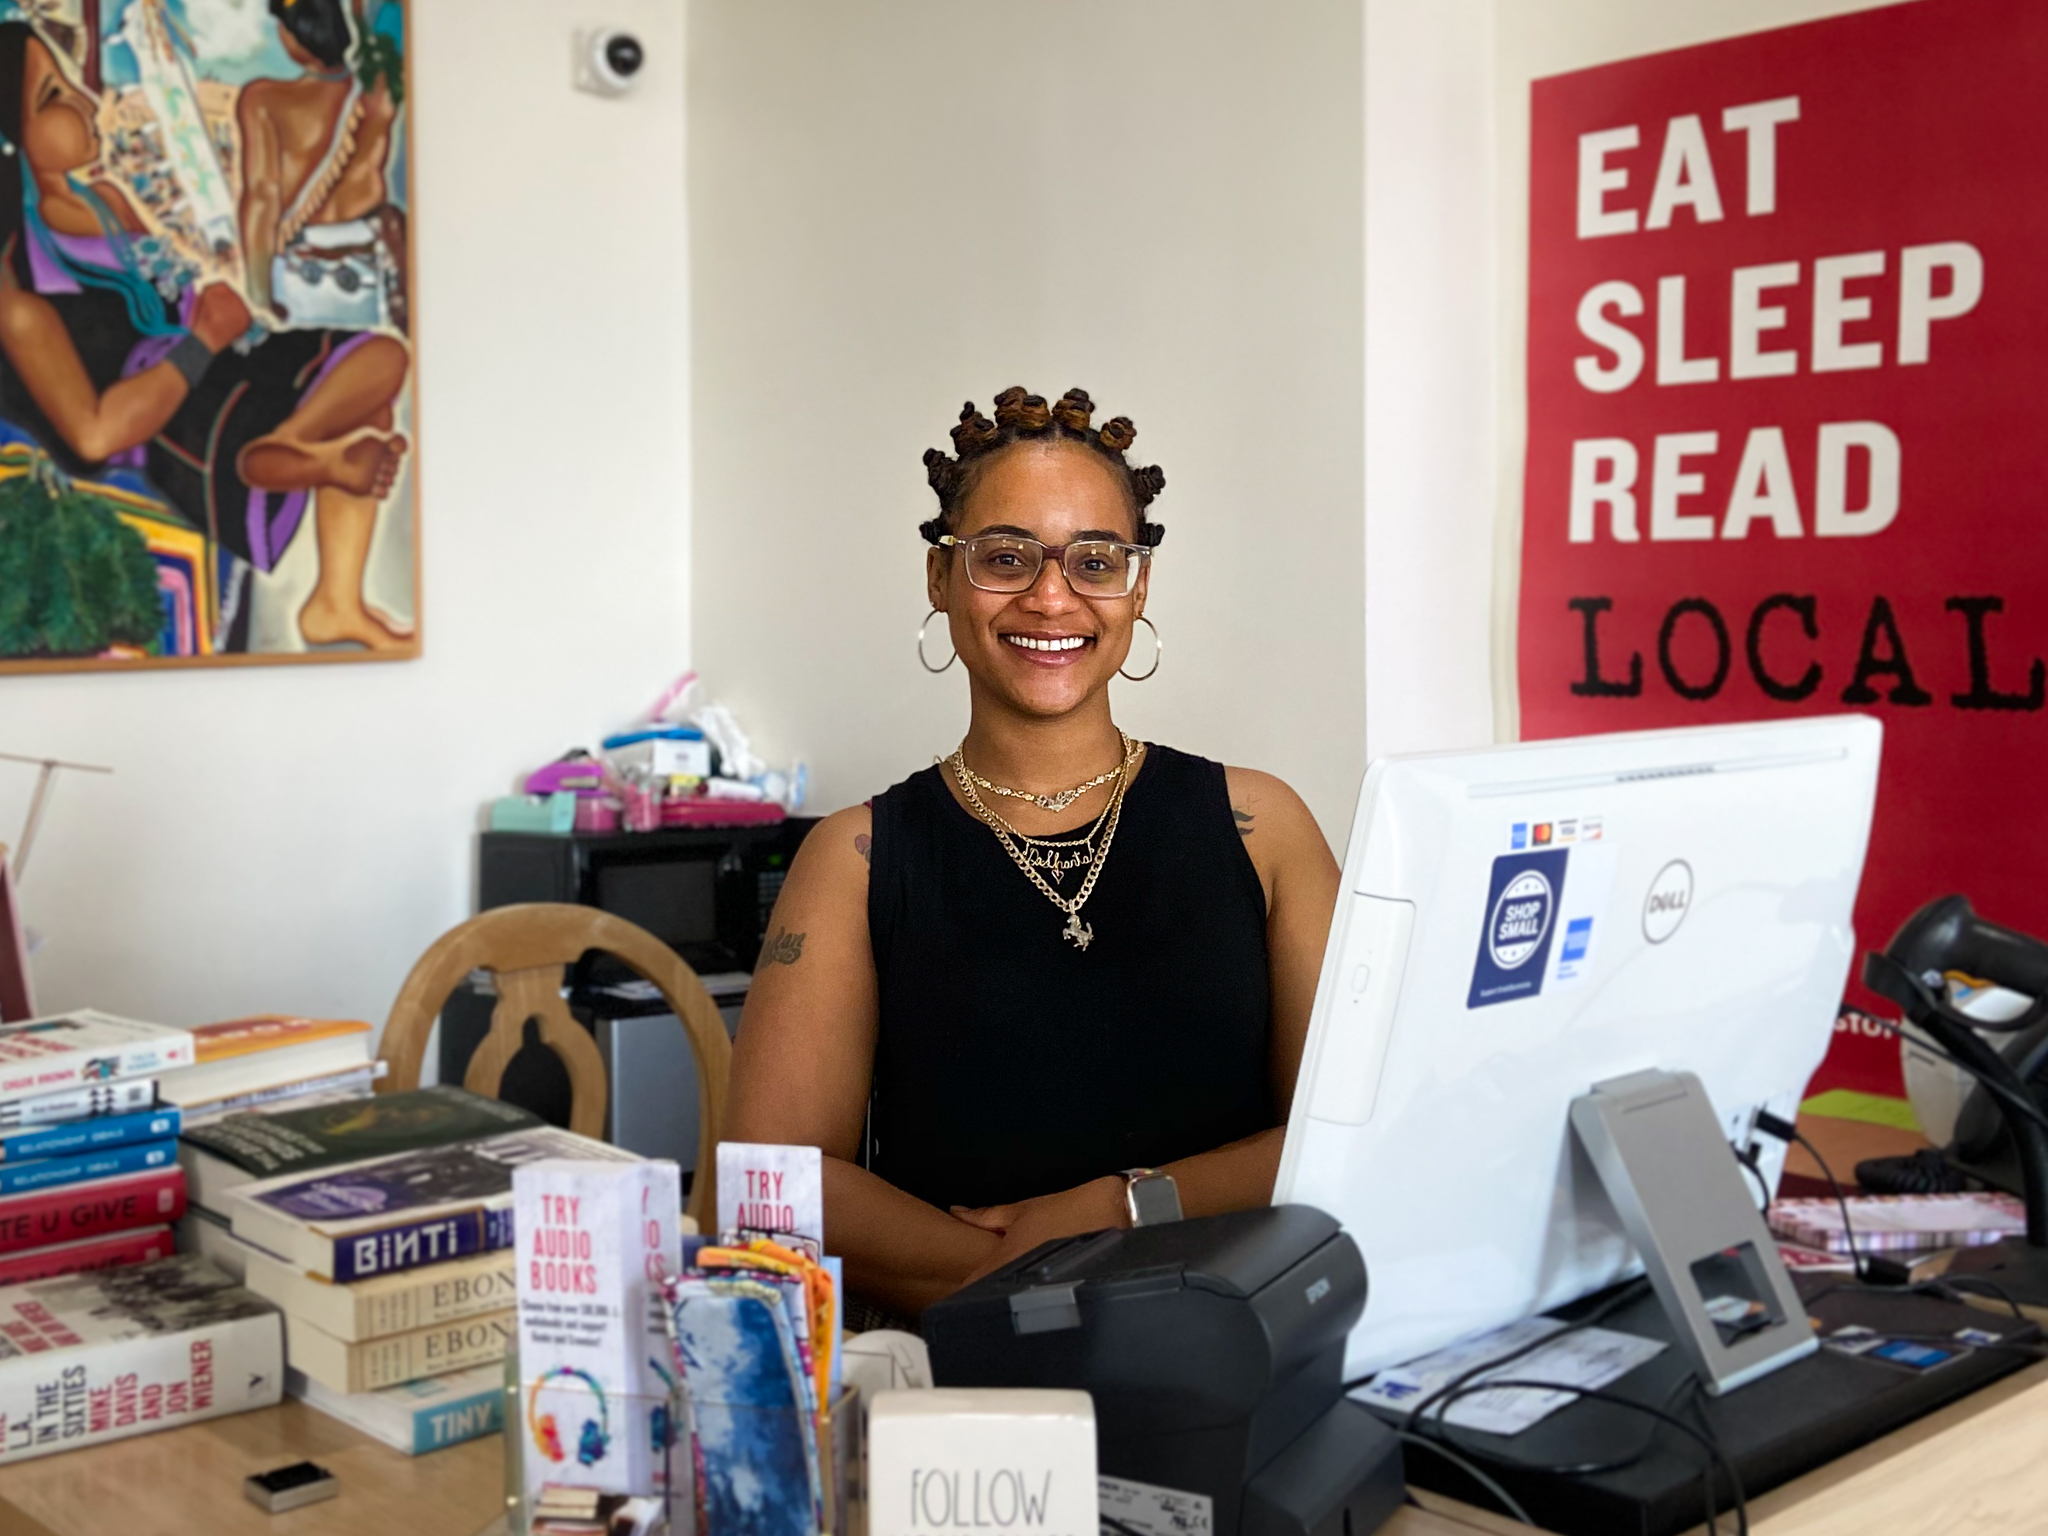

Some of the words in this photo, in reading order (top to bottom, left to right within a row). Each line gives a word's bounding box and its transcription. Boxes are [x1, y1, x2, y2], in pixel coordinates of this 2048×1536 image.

[1577, 95, 1801, 240] EAT
[1574, 241, 1984, 393] SLEEP
[1568, 421, 1901, 543] READ
[1568, 594, 2046, 711] LOCAL
[1504, 901, 1541, 923] SHOP
[1648, 889, 1685, 914] DELL
[1498, 918, 1537, 940] SMALL
[745, 1170, 784, 1200] TRY
[40, 1209, 60, 1233] U
[70, 1195, 137, 1227] GIVE
[542, 1194, 580, 1226] TRY
[737, 1202, 794, 1233] AUDIO
[534, 1227, 592, 1260] AUDIO
[531, 1260, 597, 1295] BOOKS
[190, 1338, 213, 1411] WIENER
[36, 1380, 59, 1419] THE
[62, 1365, 86, 1439] SIXTIES
[88, 1383, 112, 1433] MIKE
[114, 1372, 138, 1427] DAVIS
[141, 1383, 163, 1420] AND
[166, 1380, 188, 1415] JON
[36, 1423, 59, 1445] IN
[430, 1402, 491, 1443] TINY
[911, 1468, 1051, 1527] FOLLOW
